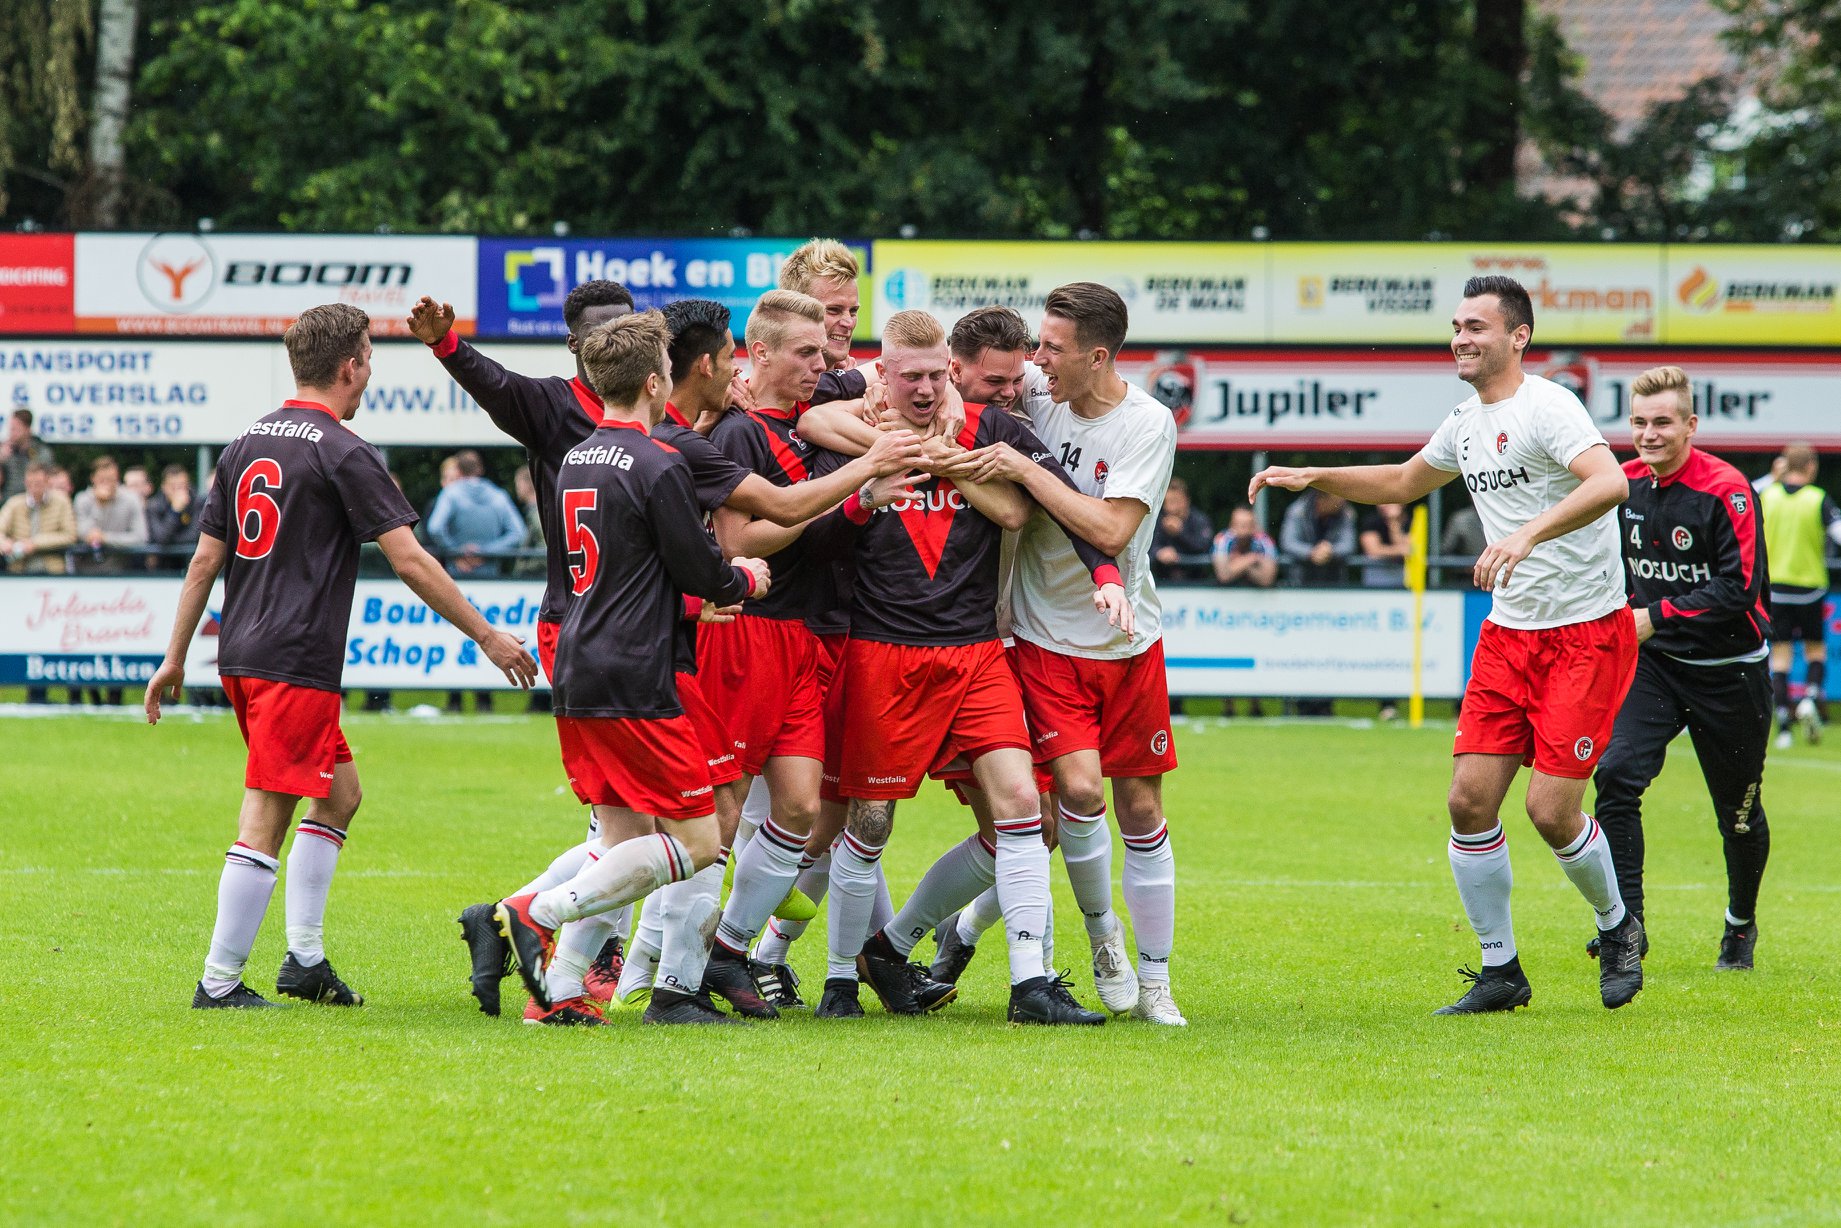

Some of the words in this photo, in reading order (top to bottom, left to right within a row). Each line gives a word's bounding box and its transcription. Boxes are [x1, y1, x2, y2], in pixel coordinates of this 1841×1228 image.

[224, 262, 412, 286] BOOM
[576, 251, 676, 287] Hoek
[686, 258, 735, 287] en
[46, 384, 208, 405] OVERSLAG
[1209, 379, 1379, 424] Jupiler
[114, 415, 183, 436] 1550
[1060, 441, 1083, 472] 14
[1467, 466, 1530, 494] OSUCH
[235, 457, 282, 560] 6
[562, 488, 599, 597] 5
[1630, 524, 1642, 550] 4
[1627, 556, 1711, 583] NOSUCH
[1196, 607, 1379, 634] Management
[26, 655, 156, 680] Betrokken
[346, 638, 445, 673] Schop
[457, 640, 478, 665] &
[867, 775, 907, 785] Westfalia
